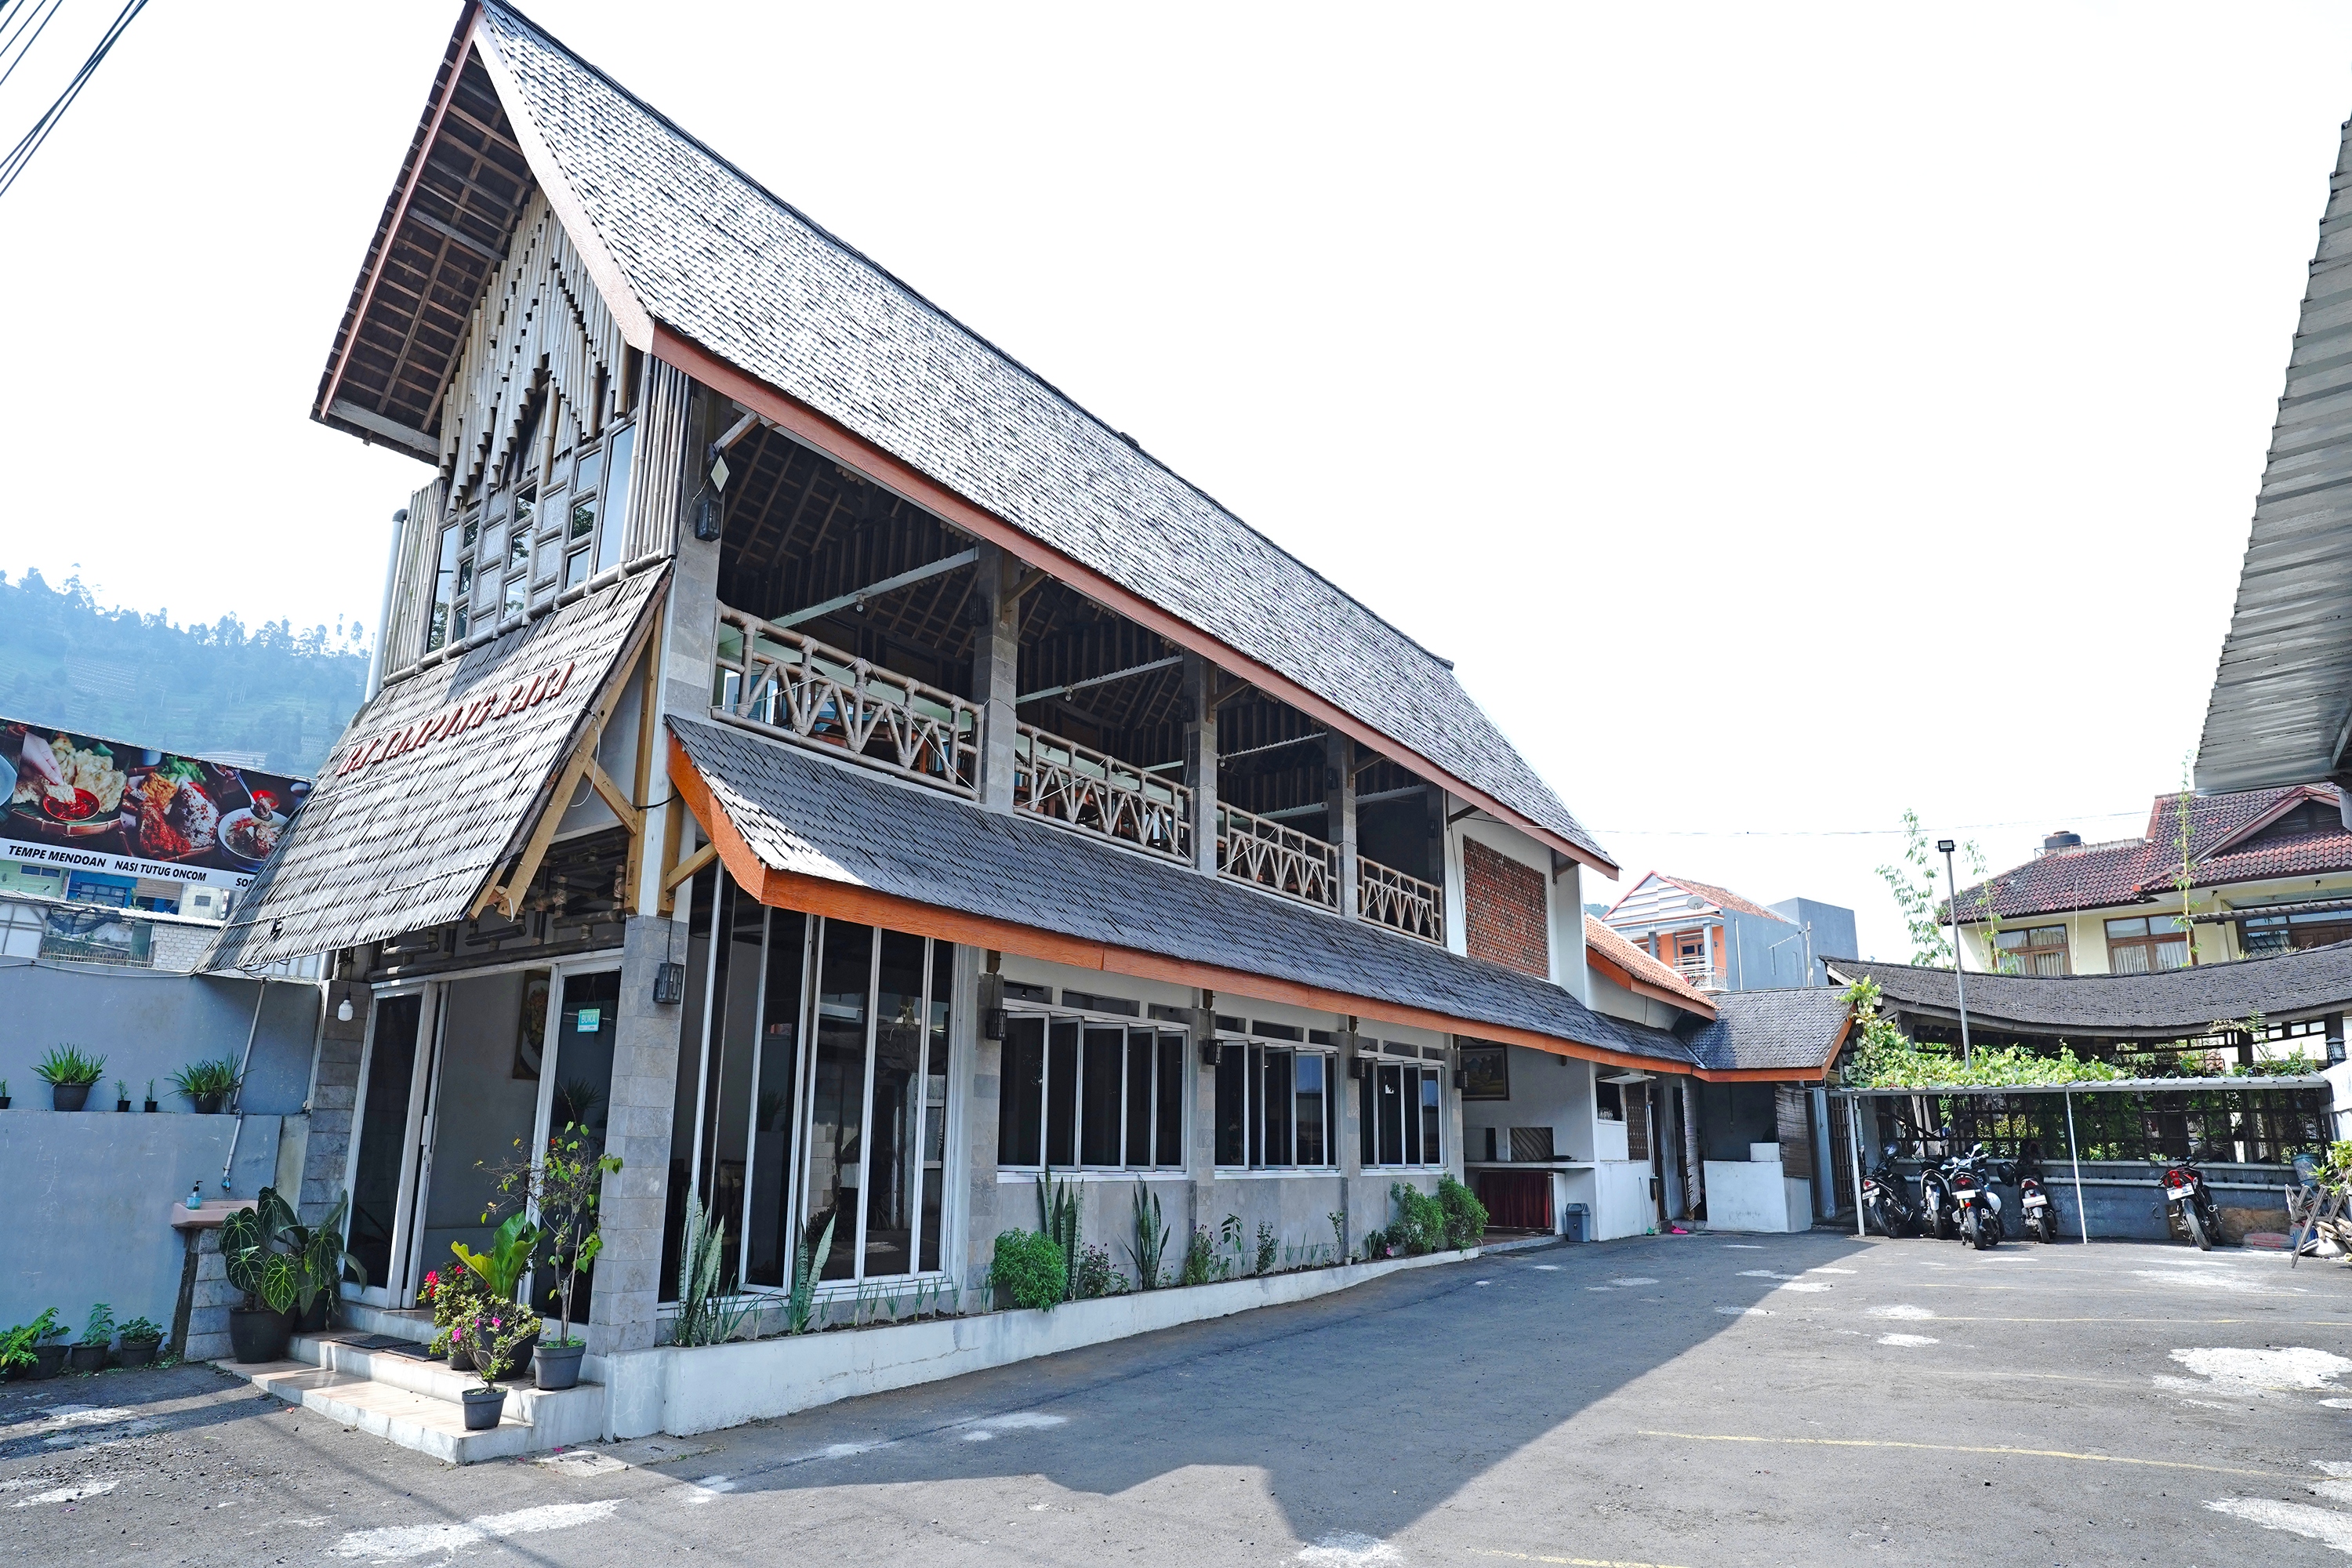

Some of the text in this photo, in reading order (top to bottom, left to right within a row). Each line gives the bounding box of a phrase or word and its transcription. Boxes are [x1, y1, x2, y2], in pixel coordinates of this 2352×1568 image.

[371, 691, 498, 765] KAMPUNG
[492, 660, 575, 720] RASA
[9, 844, 107, 868] TEMPE MENDOAN
[114, 860, 207, 882] NASI TUTUG ONCOM
[581, 1014, 596, 1024] BUKA
